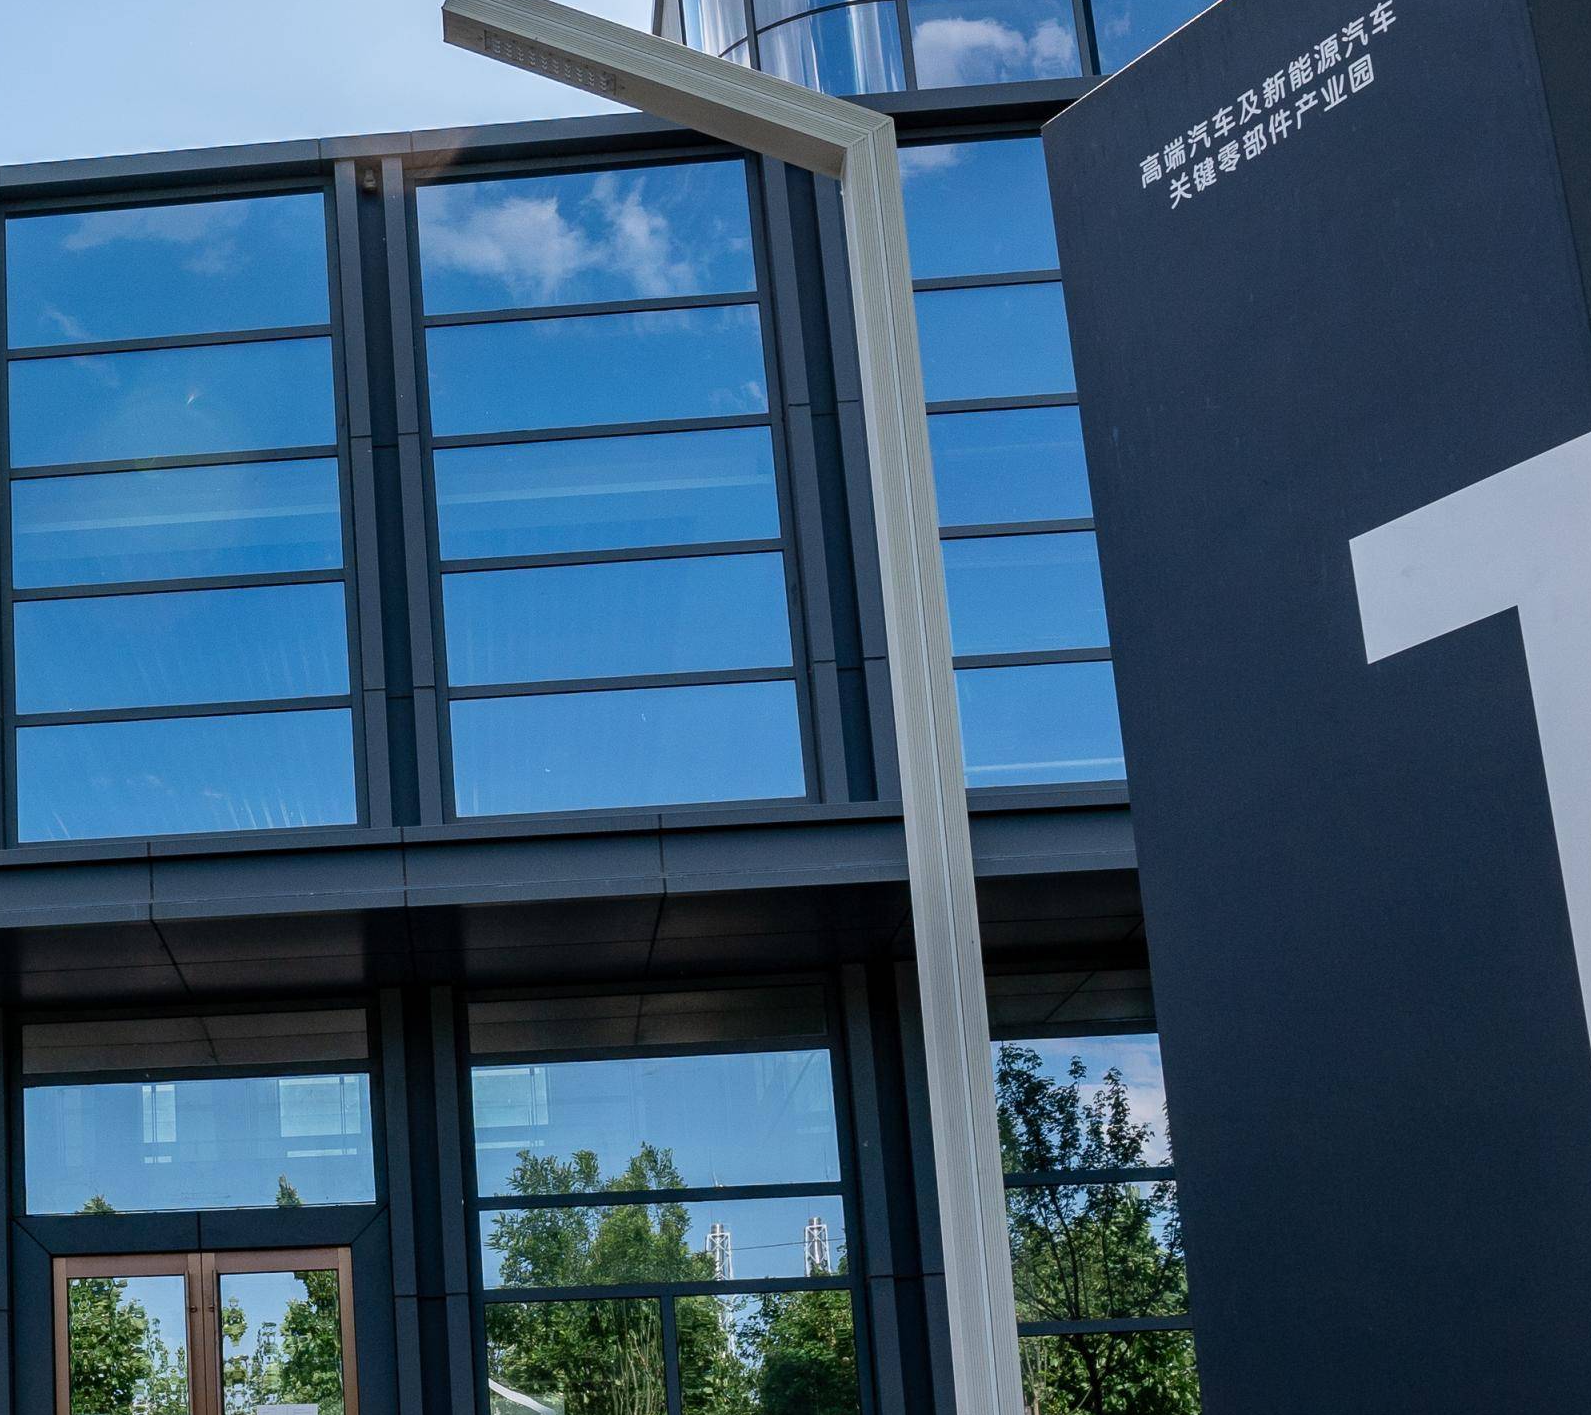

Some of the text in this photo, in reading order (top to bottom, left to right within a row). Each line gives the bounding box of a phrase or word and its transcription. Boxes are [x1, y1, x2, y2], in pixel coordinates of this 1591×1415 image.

[1169, 53, 1375, 210] 关键零部件产业园
